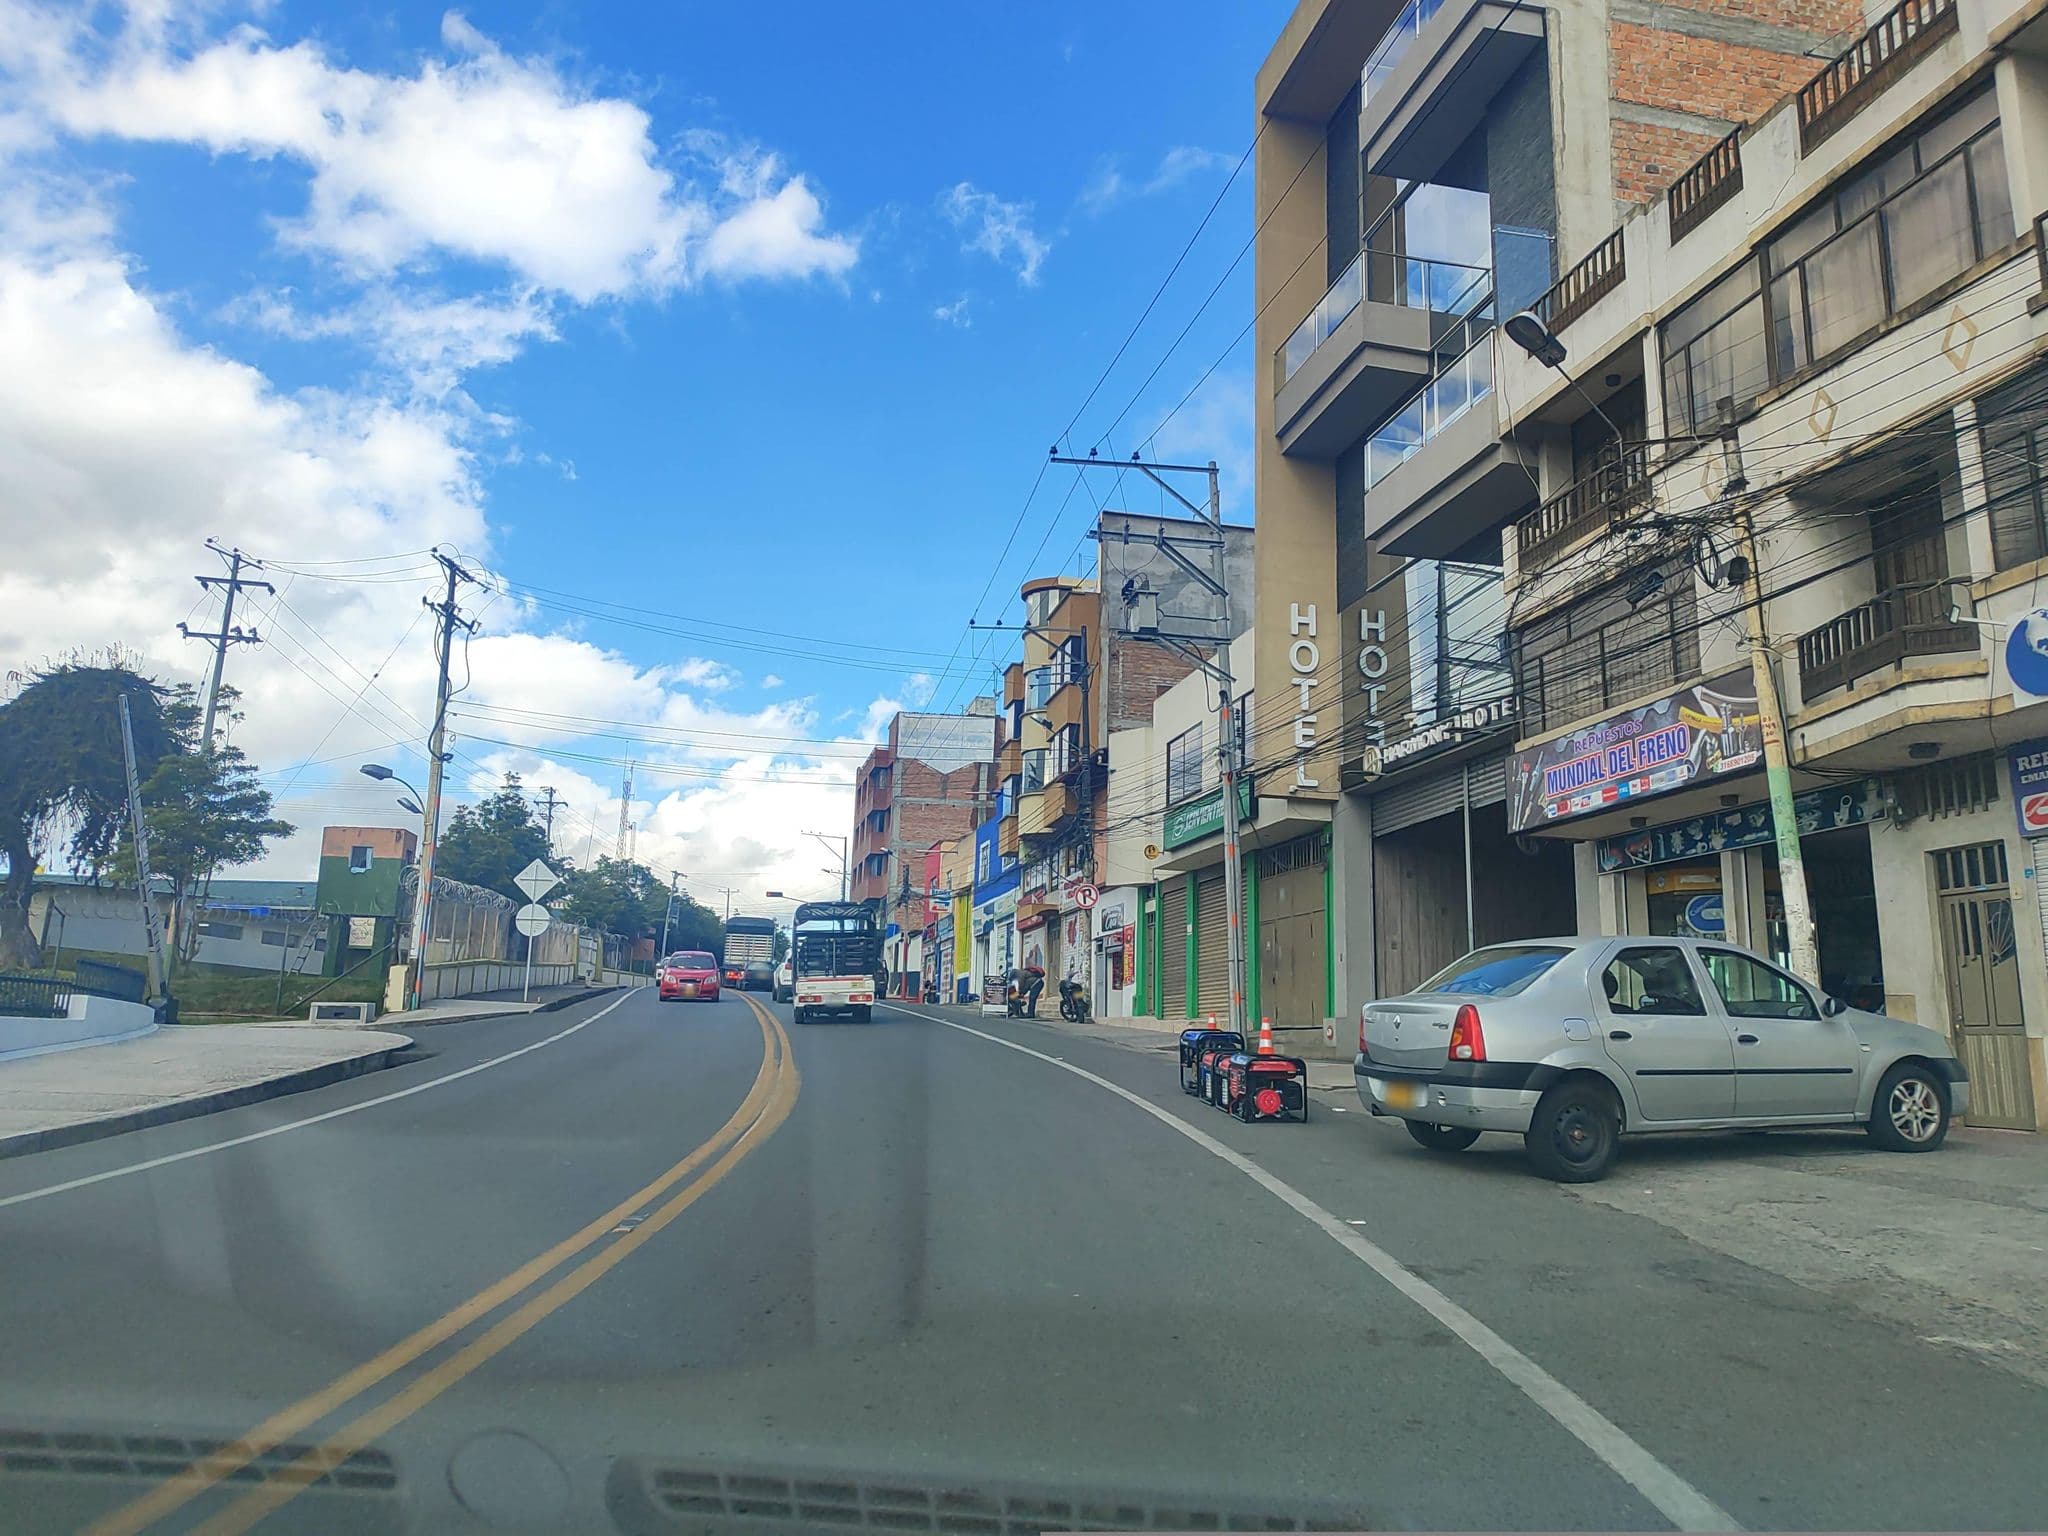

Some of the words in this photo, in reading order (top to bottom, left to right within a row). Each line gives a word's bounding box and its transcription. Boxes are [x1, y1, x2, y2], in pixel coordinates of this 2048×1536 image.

[1289, 602, 1320, 788] HOTEL
[1384, 722, 1453, 764] HARMONY
[1547, 758, 1605, 796] MUNDIAL
[1608, 744, 1635, 775] DEL
[1638, 725, 1687, 769] FRENO
[1574, 718, 1643, 753] REPUESTOS
